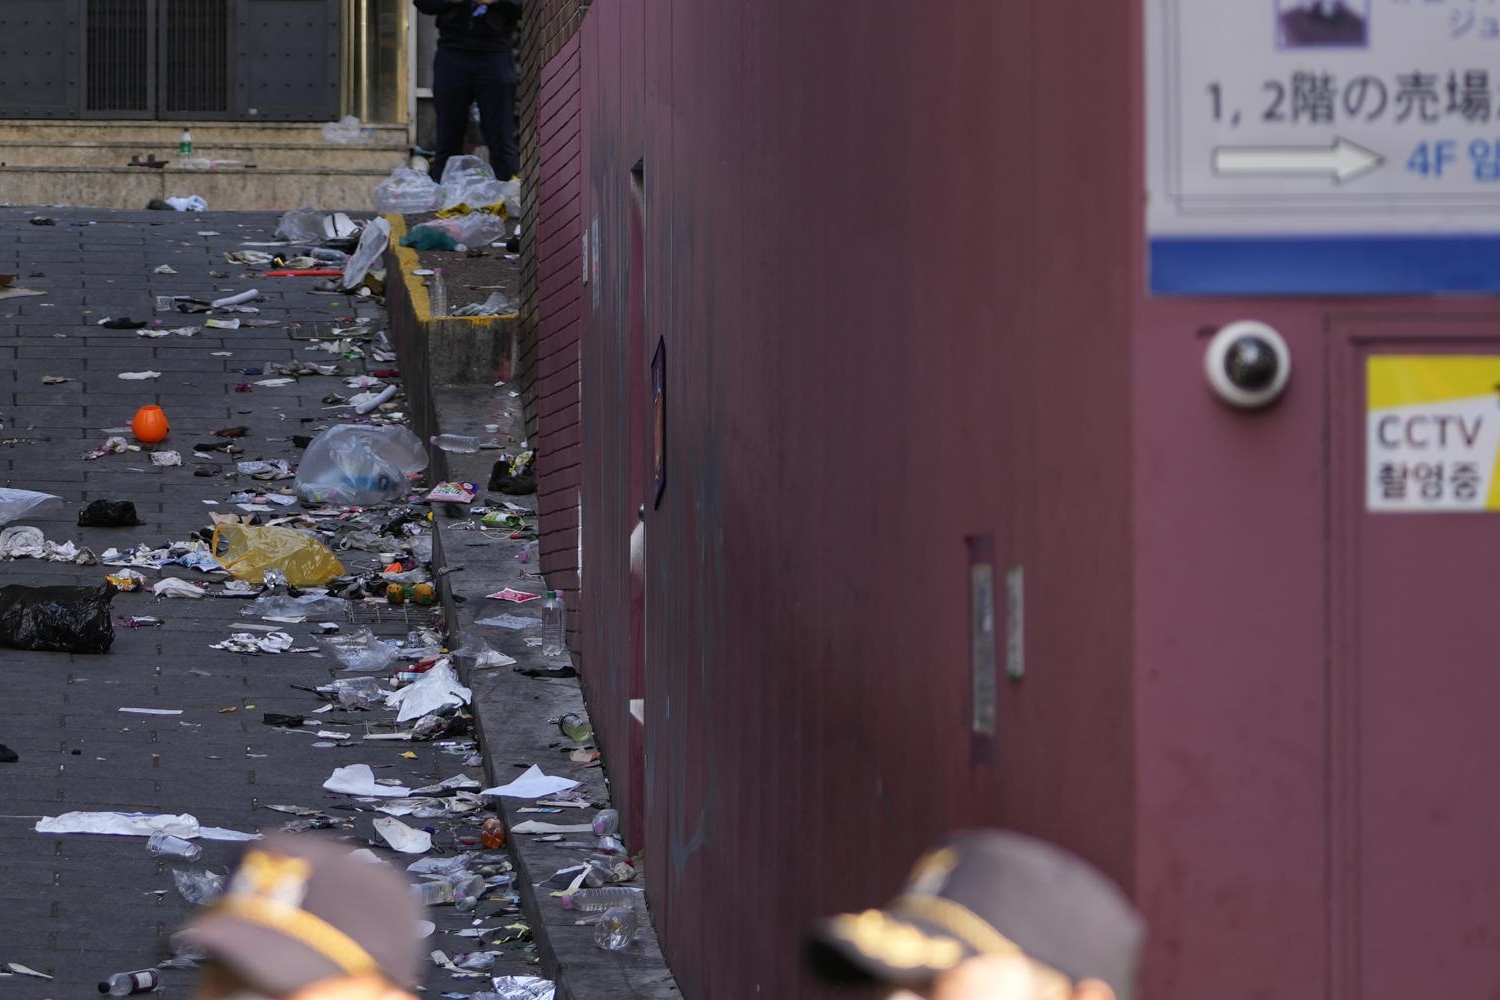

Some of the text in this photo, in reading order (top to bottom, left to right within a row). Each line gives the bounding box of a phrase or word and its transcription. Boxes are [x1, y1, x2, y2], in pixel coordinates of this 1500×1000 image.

[1405, 139, 1456, 177] 4F
[1378, 413, 1483, 450] CCTV
[1379, 461, 1481, 501] 촬영중
